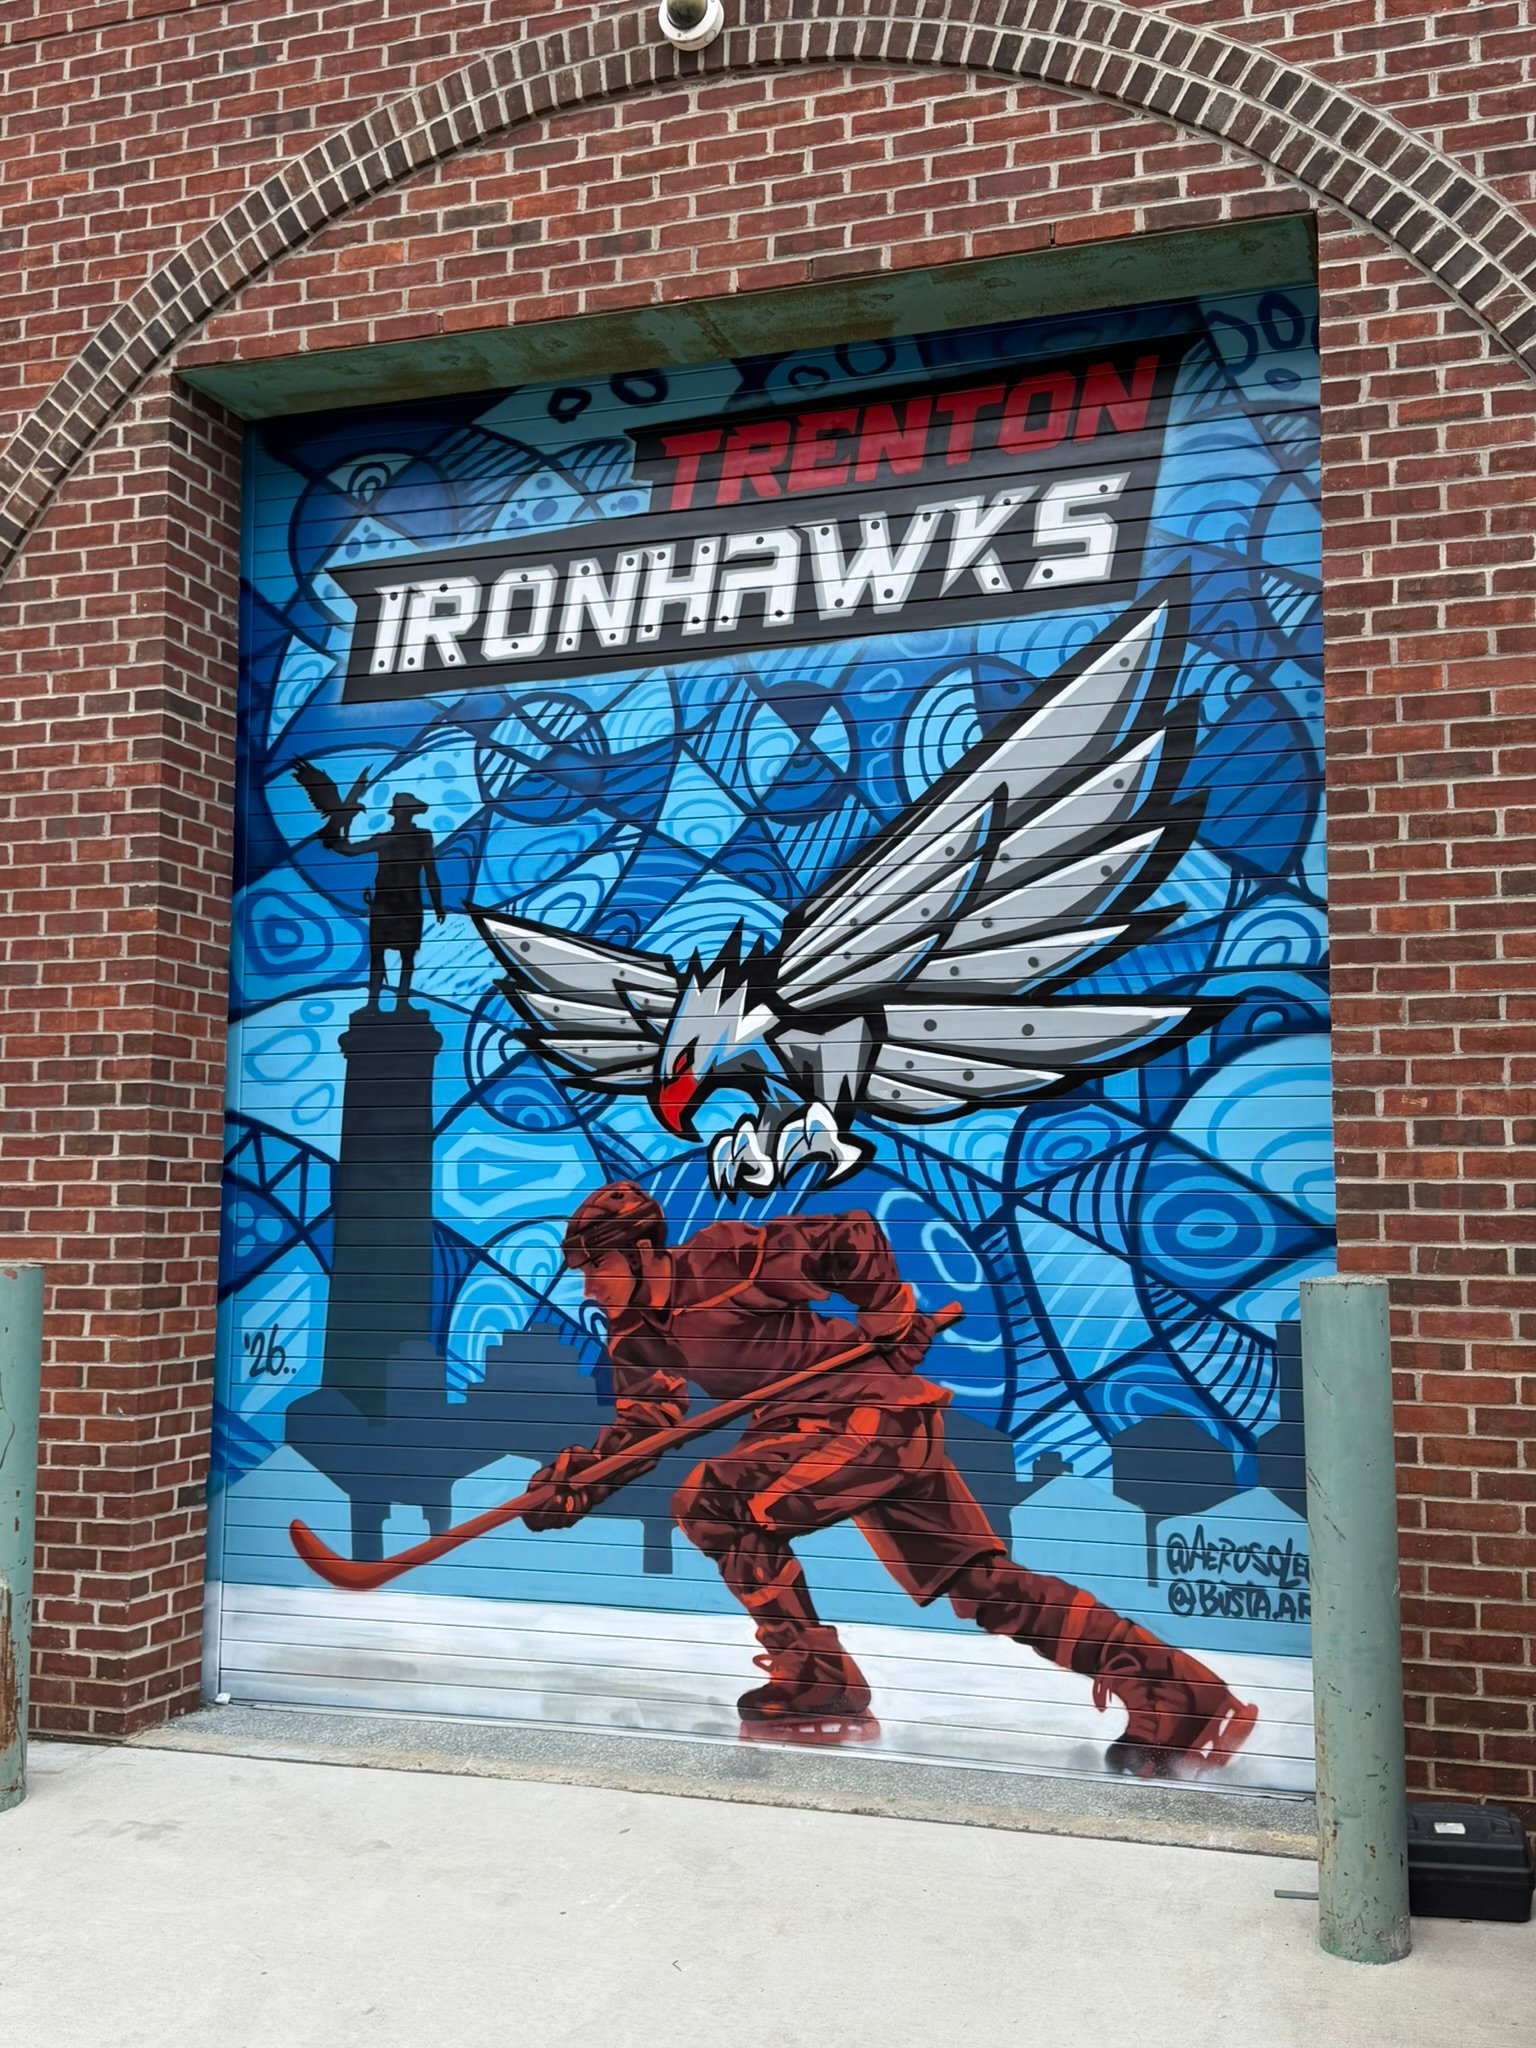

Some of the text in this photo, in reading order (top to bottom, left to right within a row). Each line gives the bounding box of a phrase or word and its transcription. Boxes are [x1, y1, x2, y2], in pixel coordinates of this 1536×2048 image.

[660, 355, 1159, 511] TRENTON
[369, 472, 1132, 675] IRONHAWKS
[1166, 1524, 1310, 1589] @AEROSOLE
